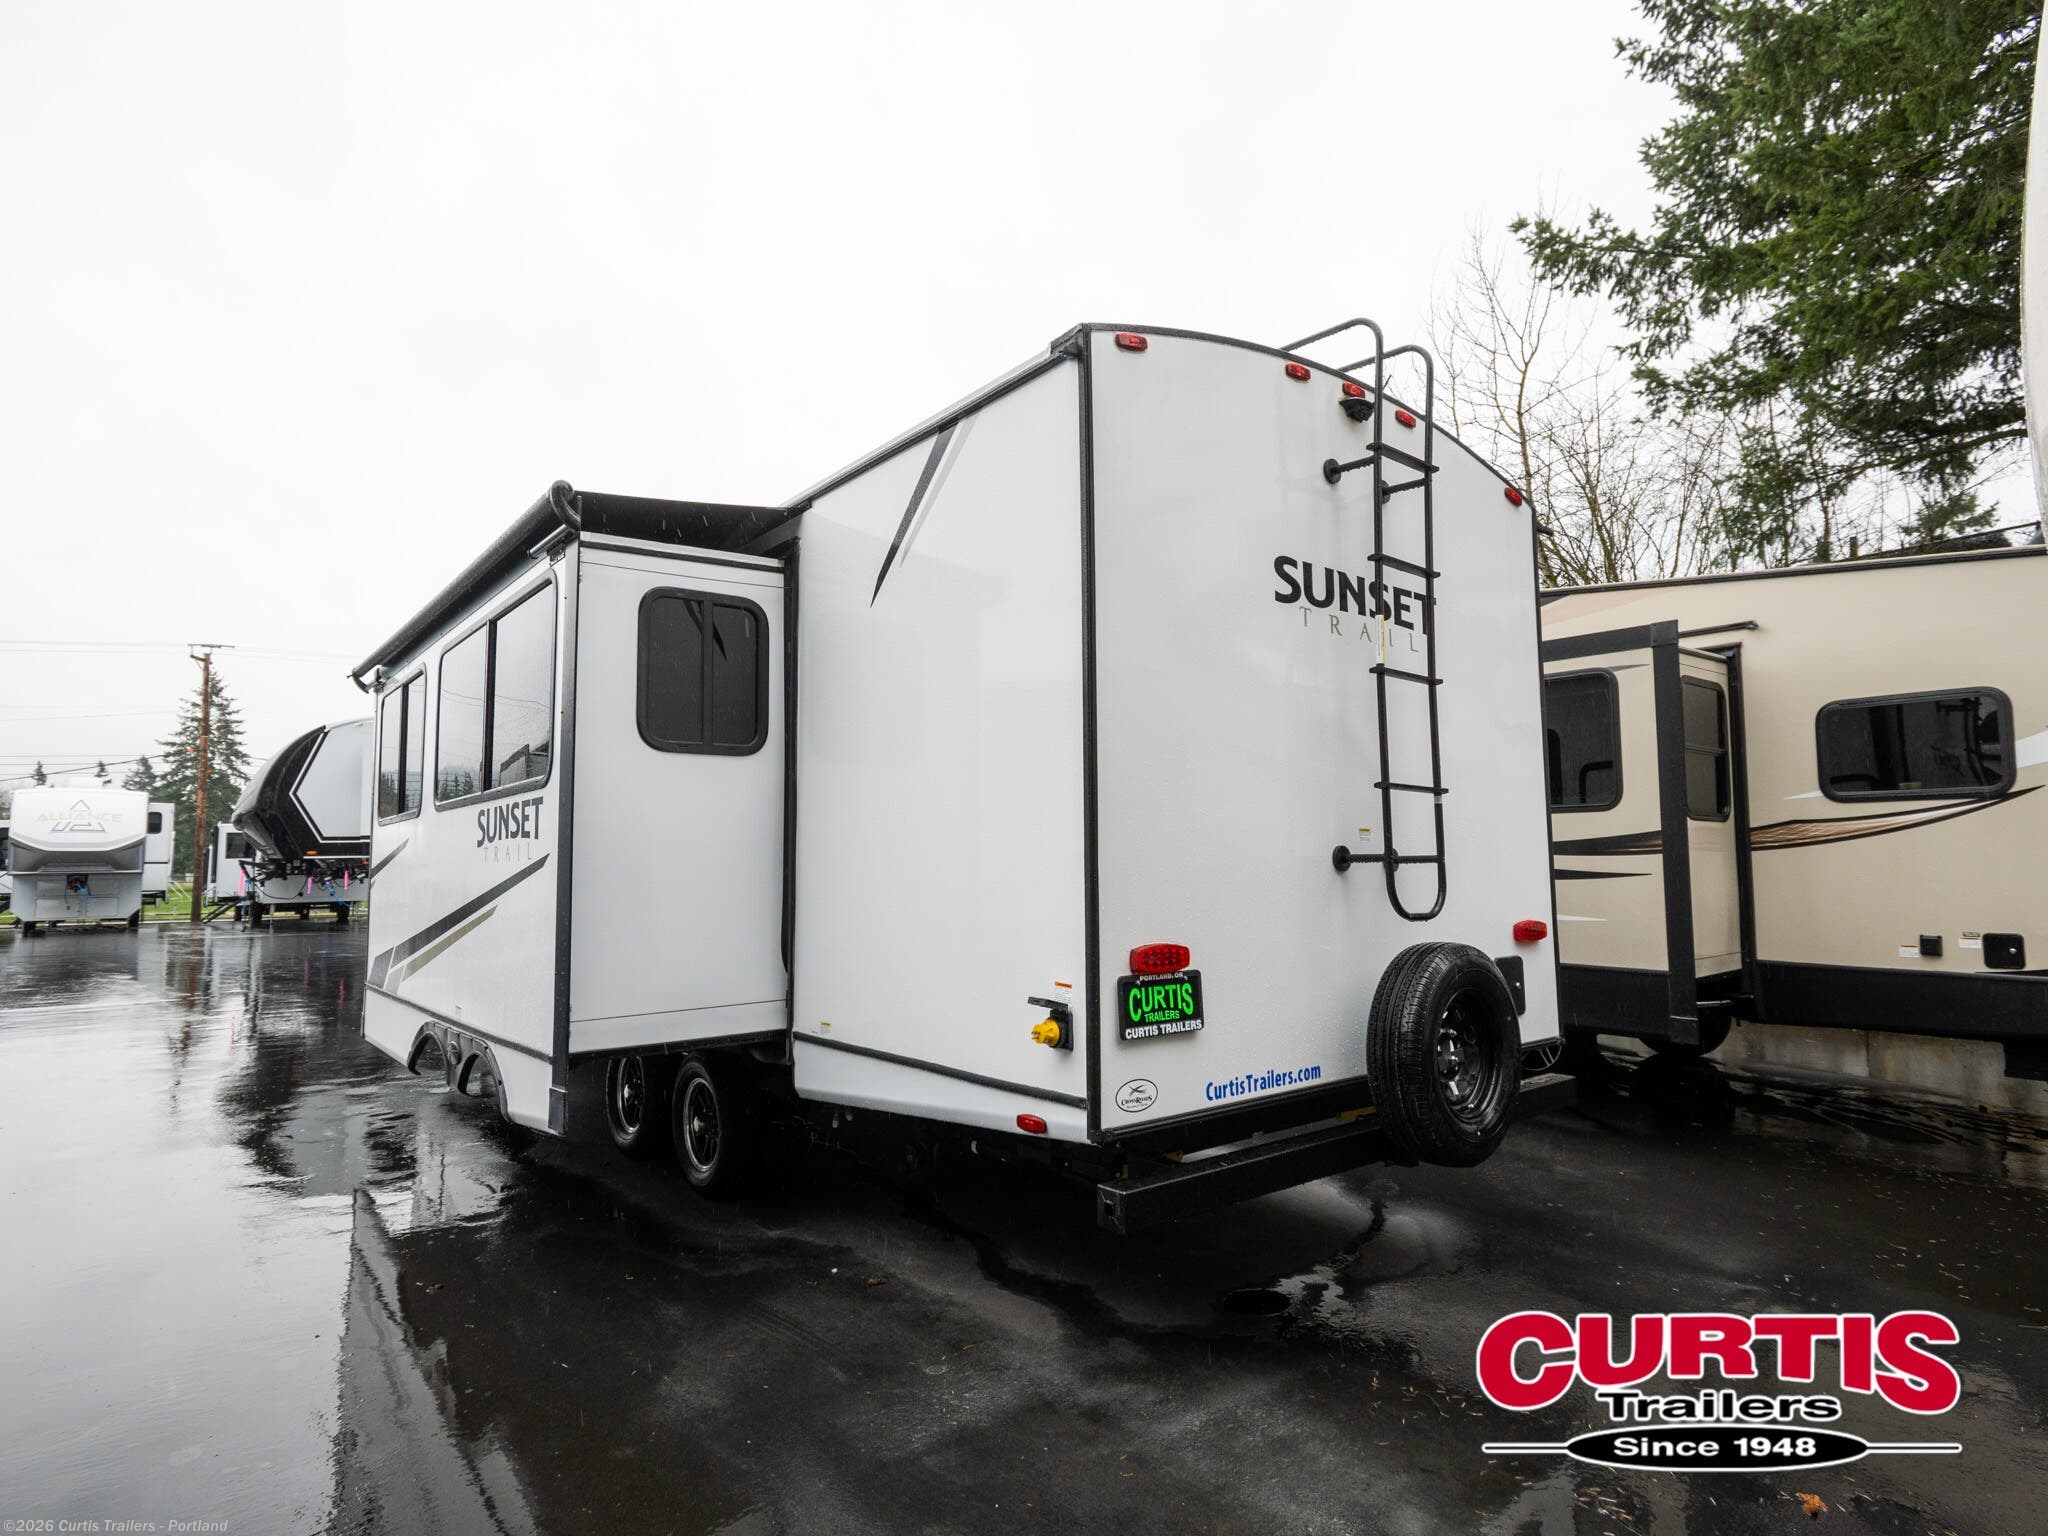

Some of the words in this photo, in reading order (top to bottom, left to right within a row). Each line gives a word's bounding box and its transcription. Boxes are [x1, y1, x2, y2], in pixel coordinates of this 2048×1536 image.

[1274, 555, 1436, 635] SUNSET
[1299, 606, 1419, 653] TRAIL
[477, 796, 543, 848] SUNSET
[483, 841, 532, 863] TRAIL
[1129, 982, 1194, 1022] CURTIS
[1144, 1010, 1180, 1023] TRAILERS
[1125, 1025, 1159, 1040] CURTIS
[1160, 1019, 1202, 1035] TRAILERS
[1205, 1064, 1321, 1101] CurtisTrailers.com
